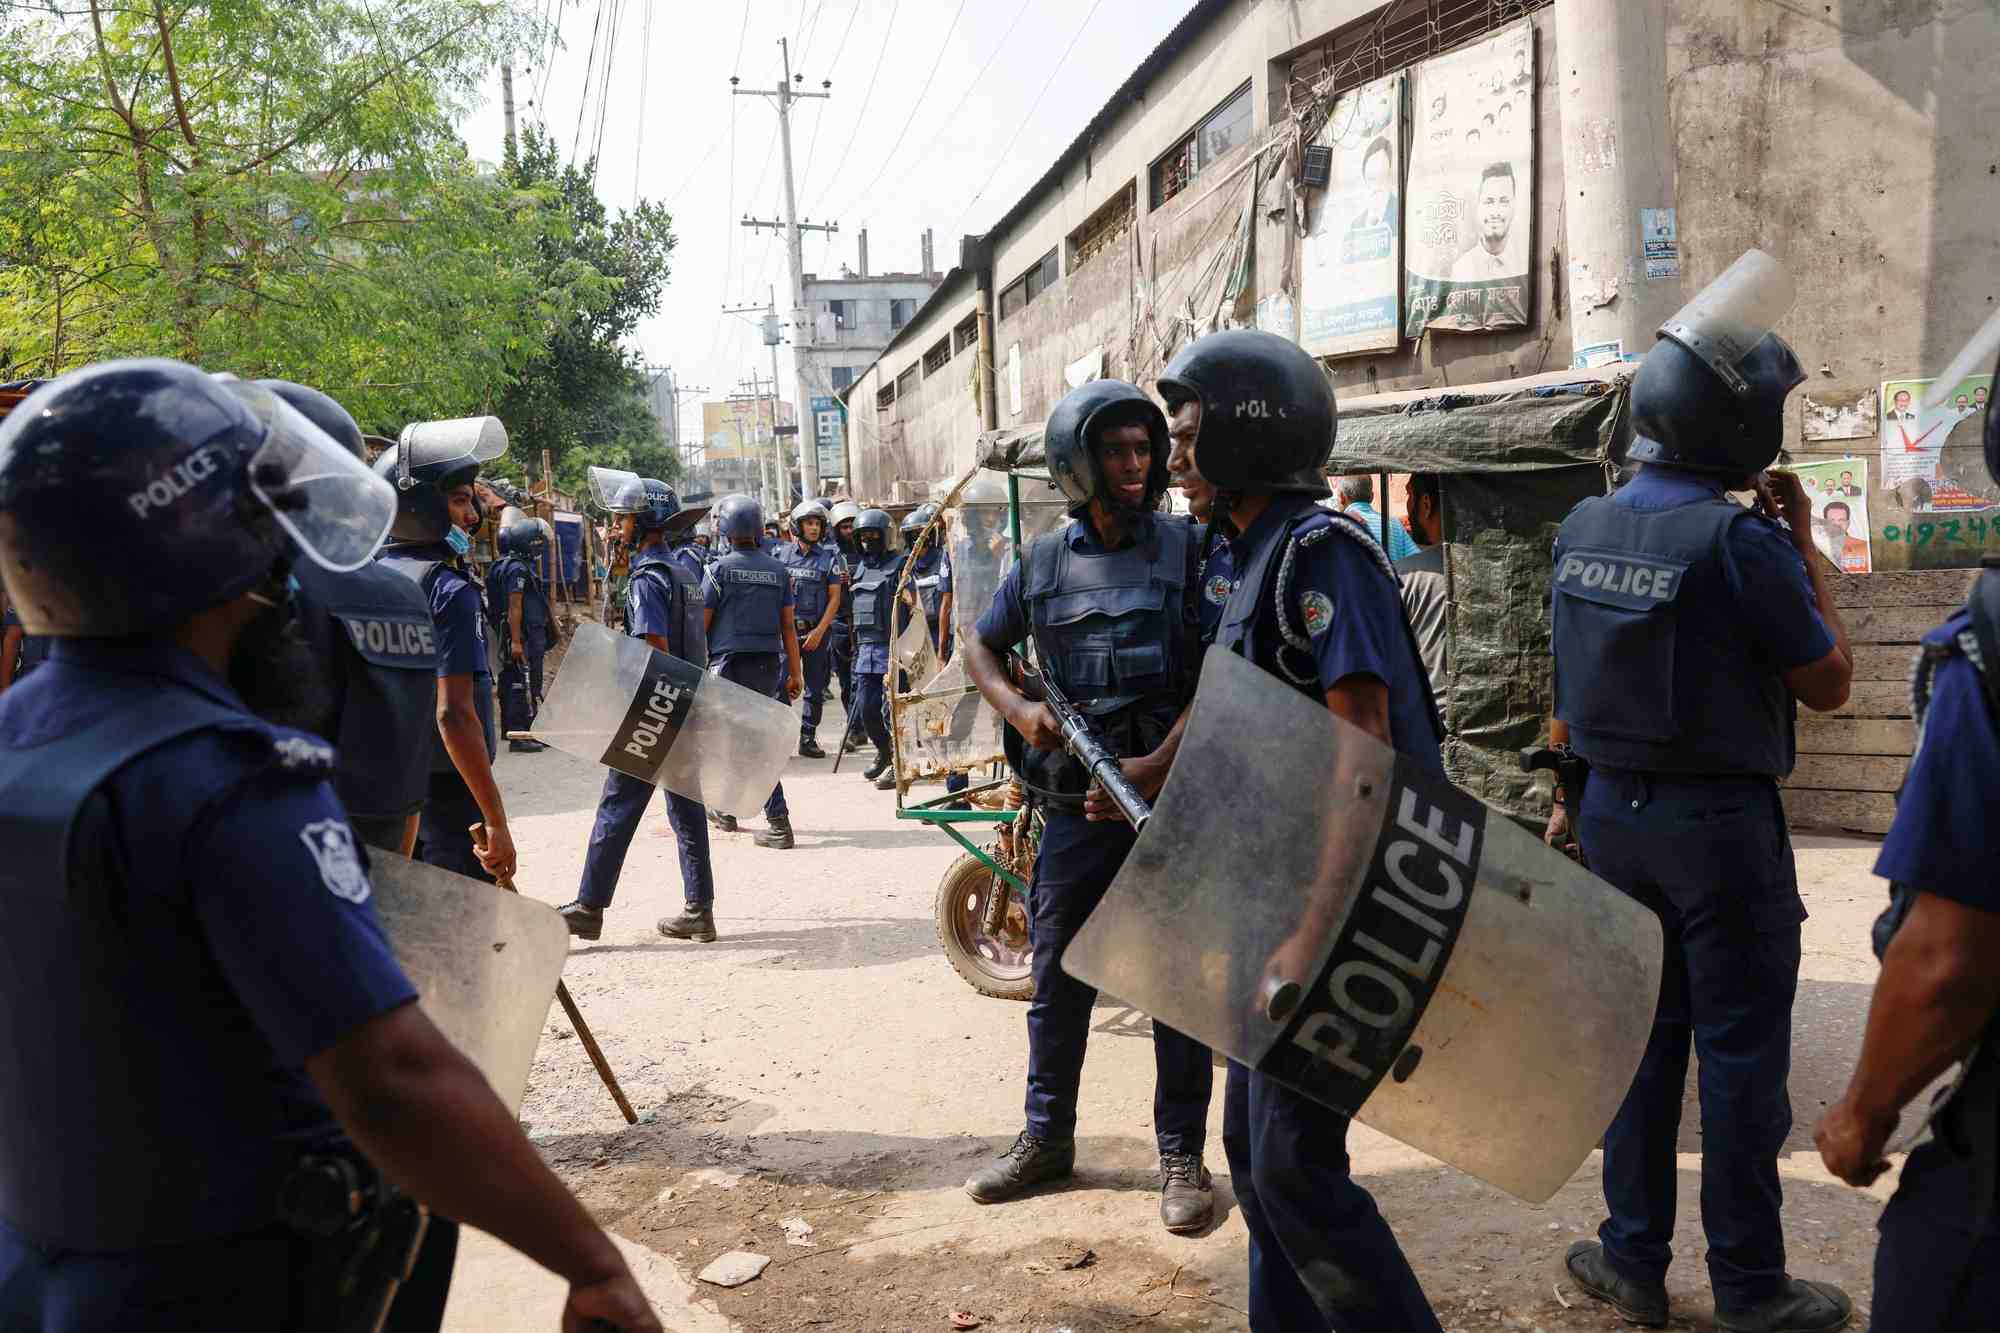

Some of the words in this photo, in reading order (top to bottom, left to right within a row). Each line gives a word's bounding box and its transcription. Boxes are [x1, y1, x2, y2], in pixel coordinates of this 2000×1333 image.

[1235, 399, 1287, 418] POL
[128, 448, 218, 519] POLICE
[645, 491, 669, 502] OLICE
[1557, 558, 1673, 599] POLICE
[349, 620, 436, 655] POLICE
[624, 680, 681, 759] POLICE
[1292, 786, 1475, 1081] POLICE
